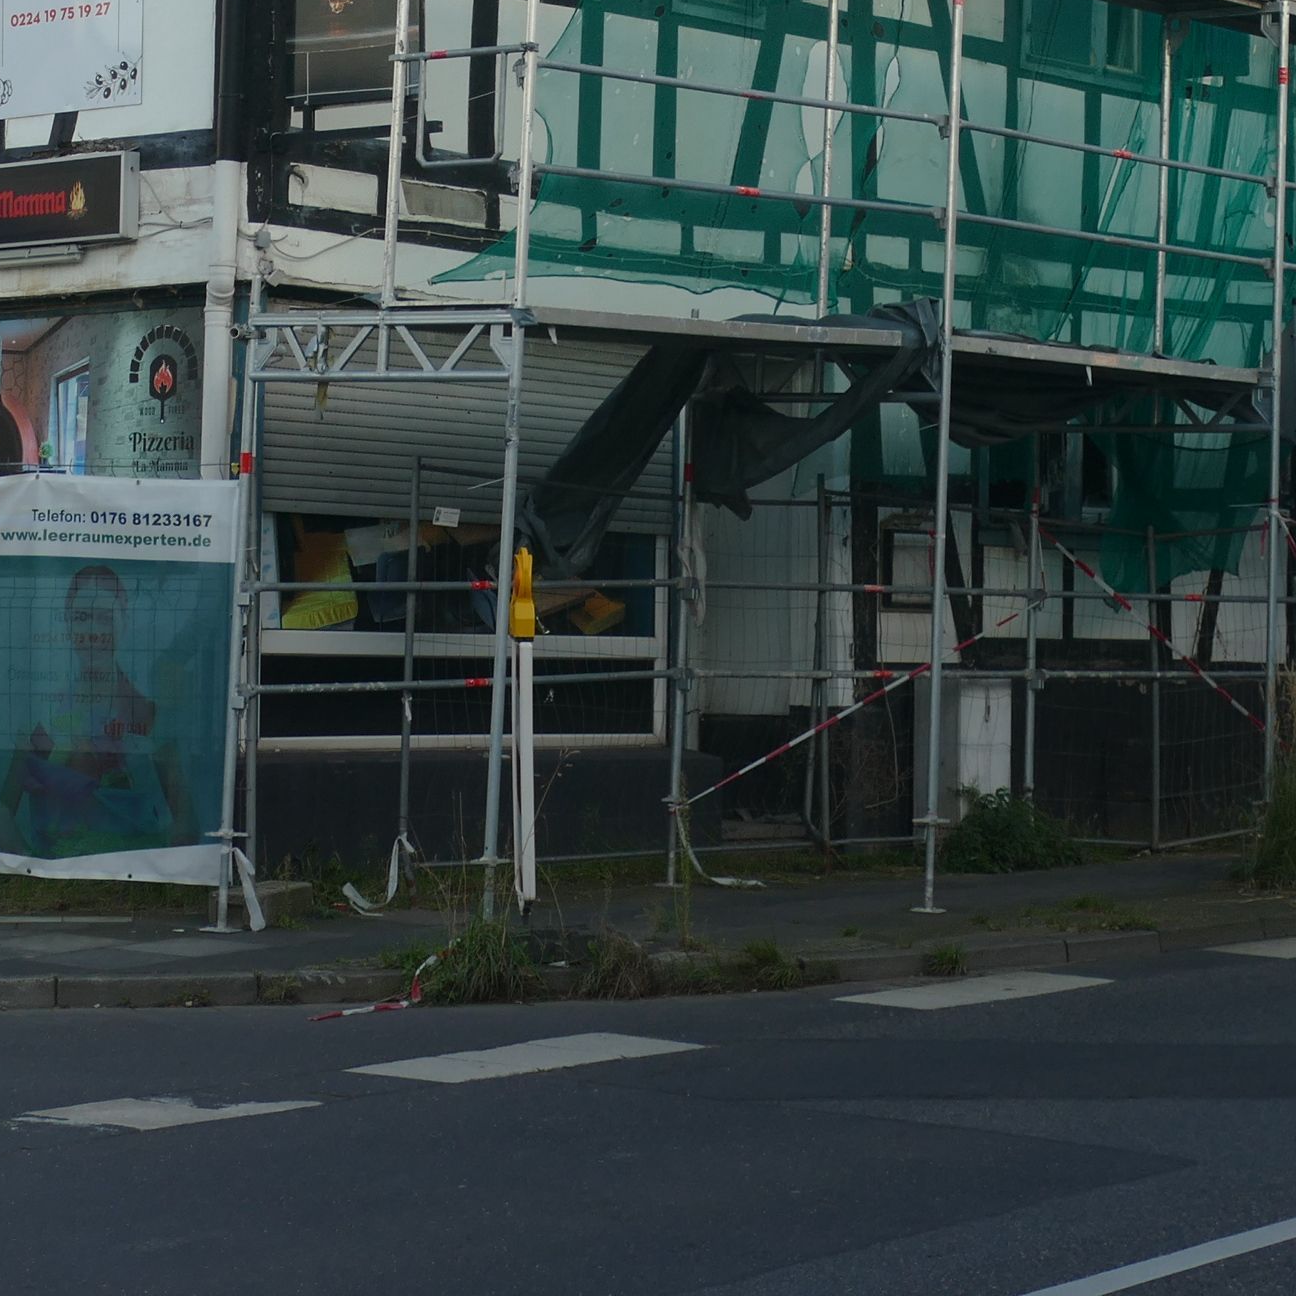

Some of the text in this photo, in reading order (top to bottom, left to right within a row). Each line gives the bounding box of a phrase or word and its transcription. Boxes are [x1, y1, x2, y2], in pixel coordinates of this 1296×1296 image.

[11, 2, 111, 27] 0224 19 75 19 27
[129, 431, 195, 452] Pizzeria
[32, 509, 212, 527] Telefon: 0176 81233167
[1, 529, 212, 548] www.leerraumexperten.de
